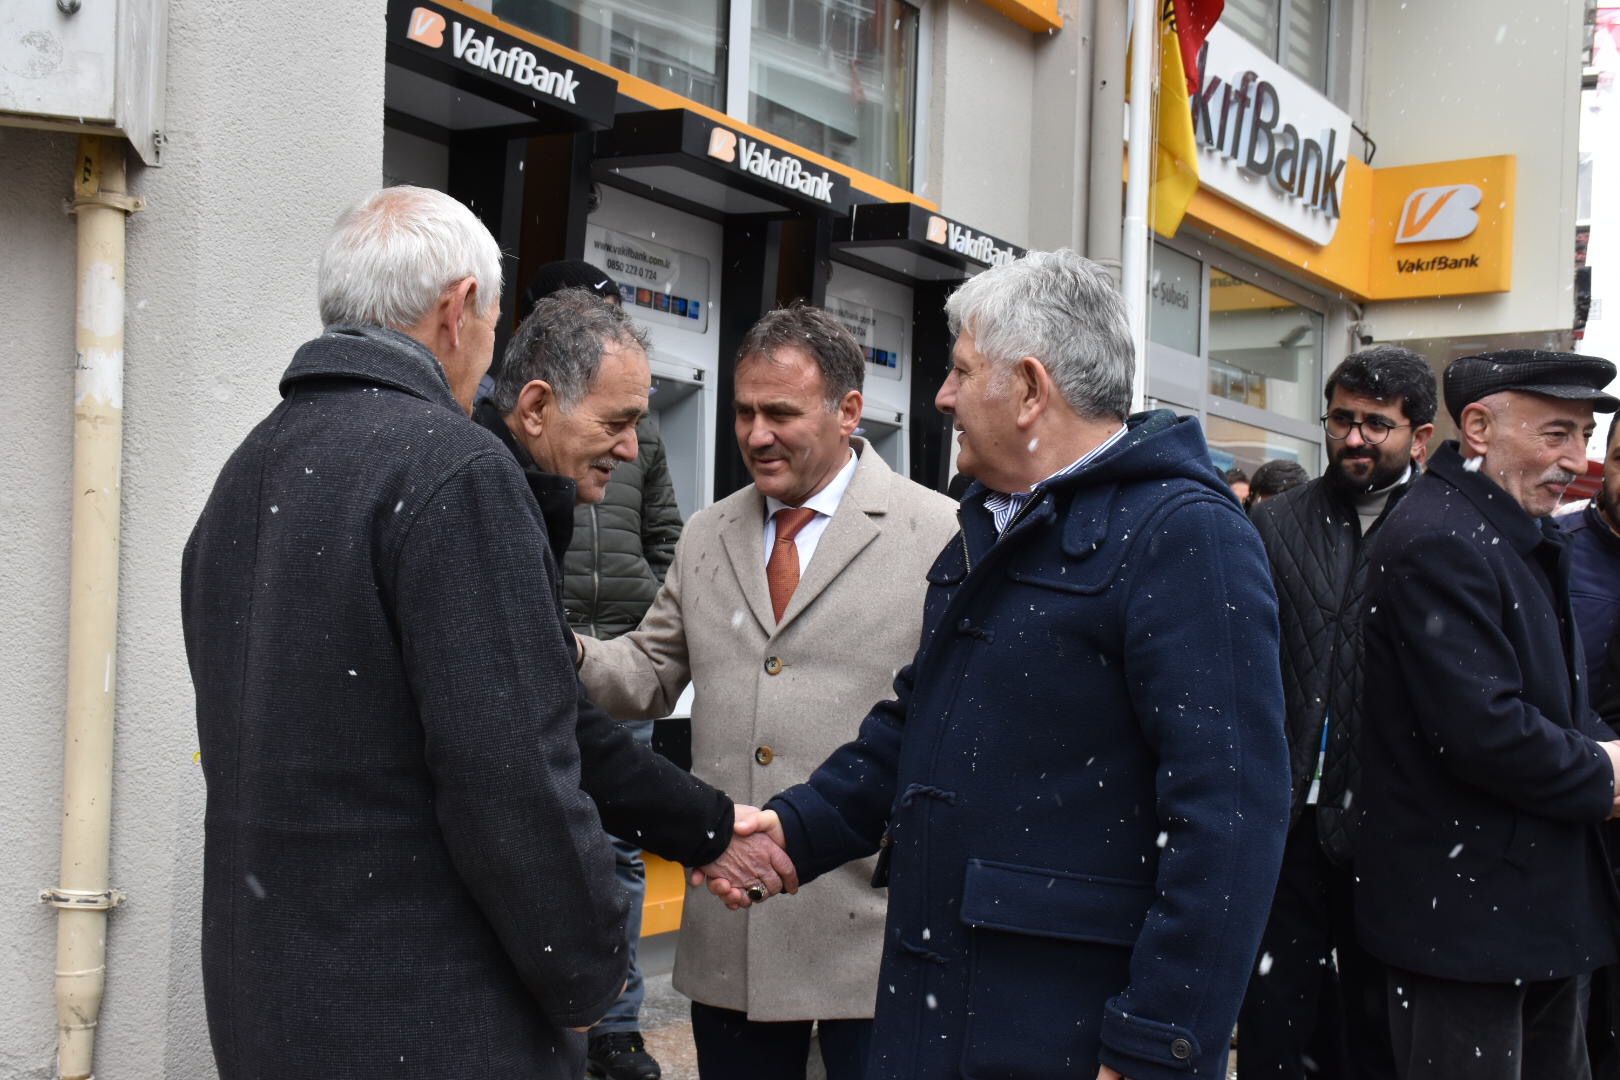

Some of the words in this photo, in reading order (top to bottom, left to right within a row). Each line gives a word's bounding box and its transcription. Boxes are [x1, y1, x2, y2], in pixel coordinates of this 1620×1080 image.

[452, 21, 580, 104] VakıfBank
[1190, 40, 1347, 219] kıfBank
[739, 137, 834, 203] VakıfBank
[607, 258, 624, 272] 0850
[645, 268, 657, 281] 724
[1397, 254, 1480, 273] VakıfBank
